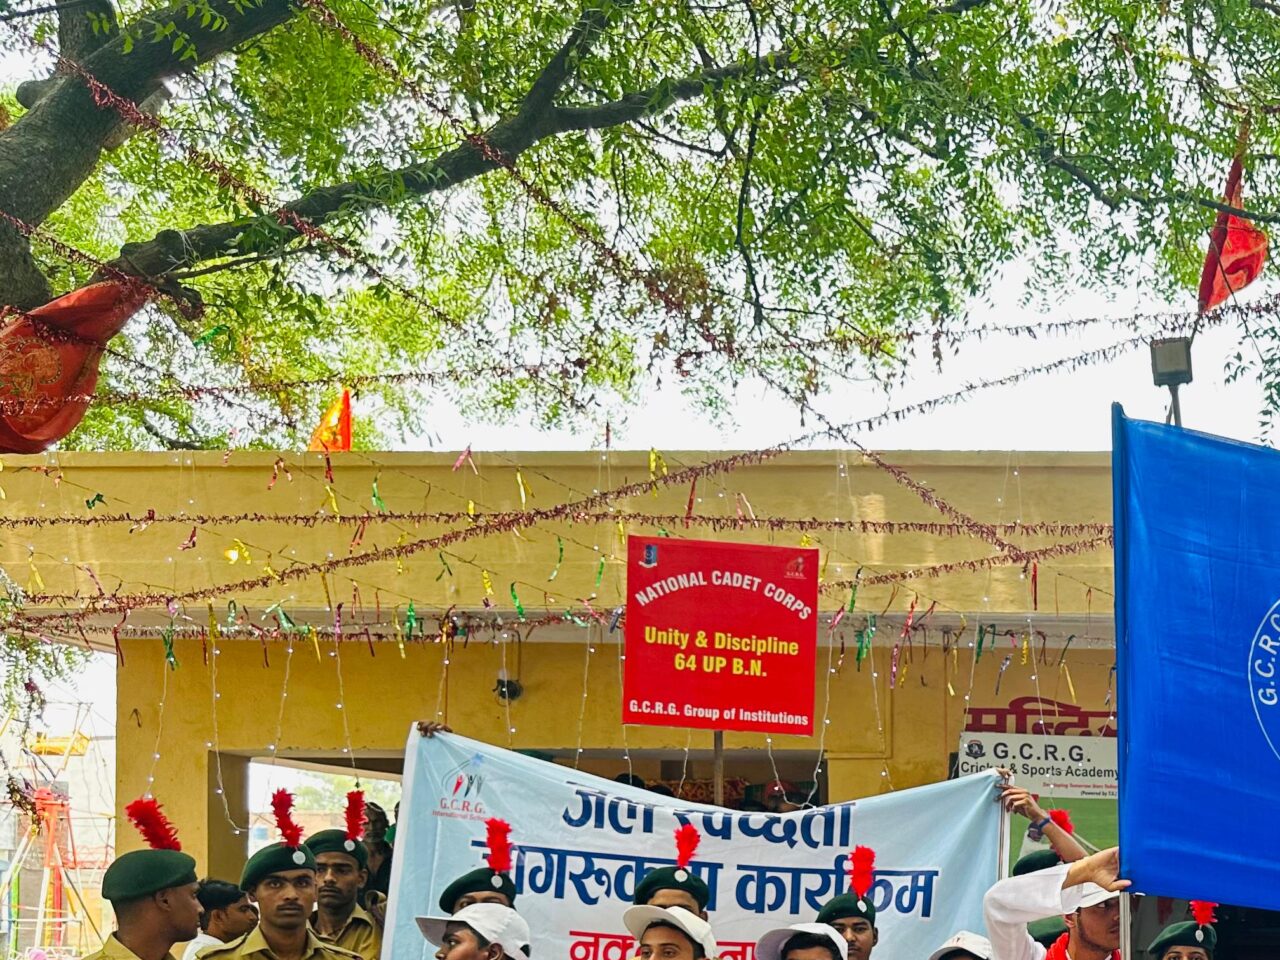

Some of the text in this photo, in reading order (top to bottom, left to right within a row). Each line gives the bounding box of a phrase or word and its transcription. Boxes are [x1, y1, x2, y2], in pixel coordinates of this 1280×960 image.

[635, 571, 811, 619] NATIONAL CADET CORPS
[645, 627, 799, 655] Unity & Discipline
[675, 654, 767, 676] 64 UP B.N.
[629, 700, 808, 725] G.C.R.G. Group of Institutions
[994, 743, 1091, 762] G.C.R.G.
[961, 762, 1004, 773] Cric
[1009, 763, 1018, 774] &
[1021, 763, 1062, 778] Sports
[441, 798, 486, 813] G.C.R.G.
